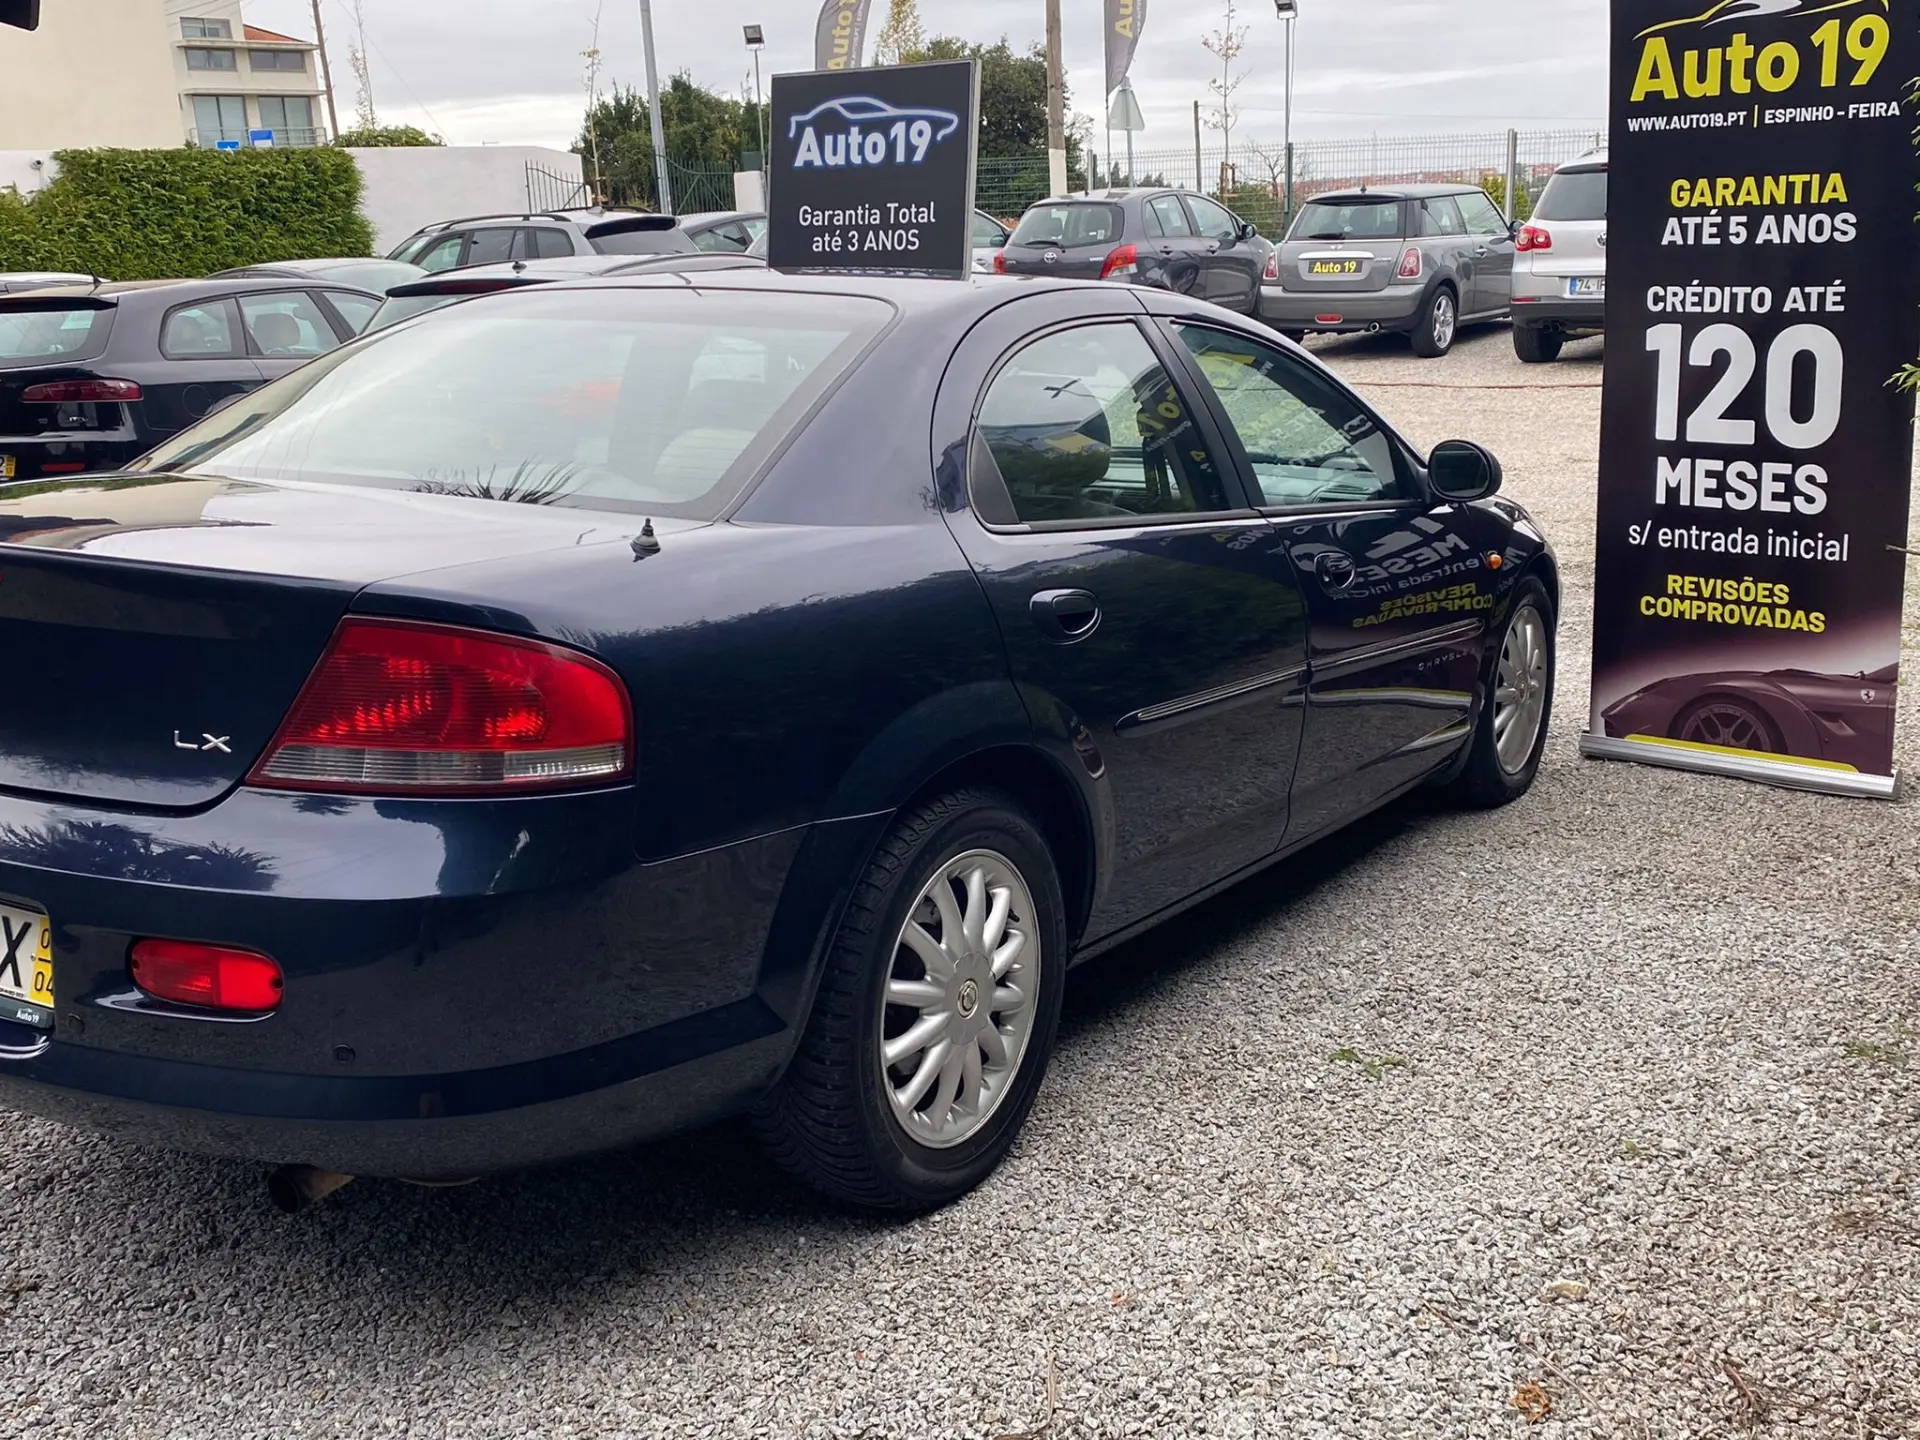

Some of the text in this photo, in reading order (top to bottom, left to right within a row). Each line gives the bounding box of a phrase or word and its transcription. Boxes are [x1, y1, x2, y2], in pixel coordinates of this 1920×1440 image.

[1630, 14, 1890, 102] Auto 19
[1627, 111, 1747, 132] WWW.AUTO19.PT
[1764, 105, 1834, 124] ESPINHO
[1848, 101, 1900, 119] FEIRA
[1670, 173, 1848, 207] GARANTIA
[799, 201, 936, 227] Garantia Total
[1661, 209, 1857, 246] ATÉ 5 ANOS
[812, 229, 920, 252] até 3 ANOS
[1313, 261, 1357, 273] Auto 19
[1646, 279, 1845, 313] CRÉDITO ATÉ
[1645, 323, 1843, 449] 120
[1655, 456, 1828, 515] MESES
[1628, 521, 1849, 562] s/ entrada inicial
[1667, 574, 1789, 605] REVISÕES
[1640, 597, 1825, 633] COMPROVADAS
